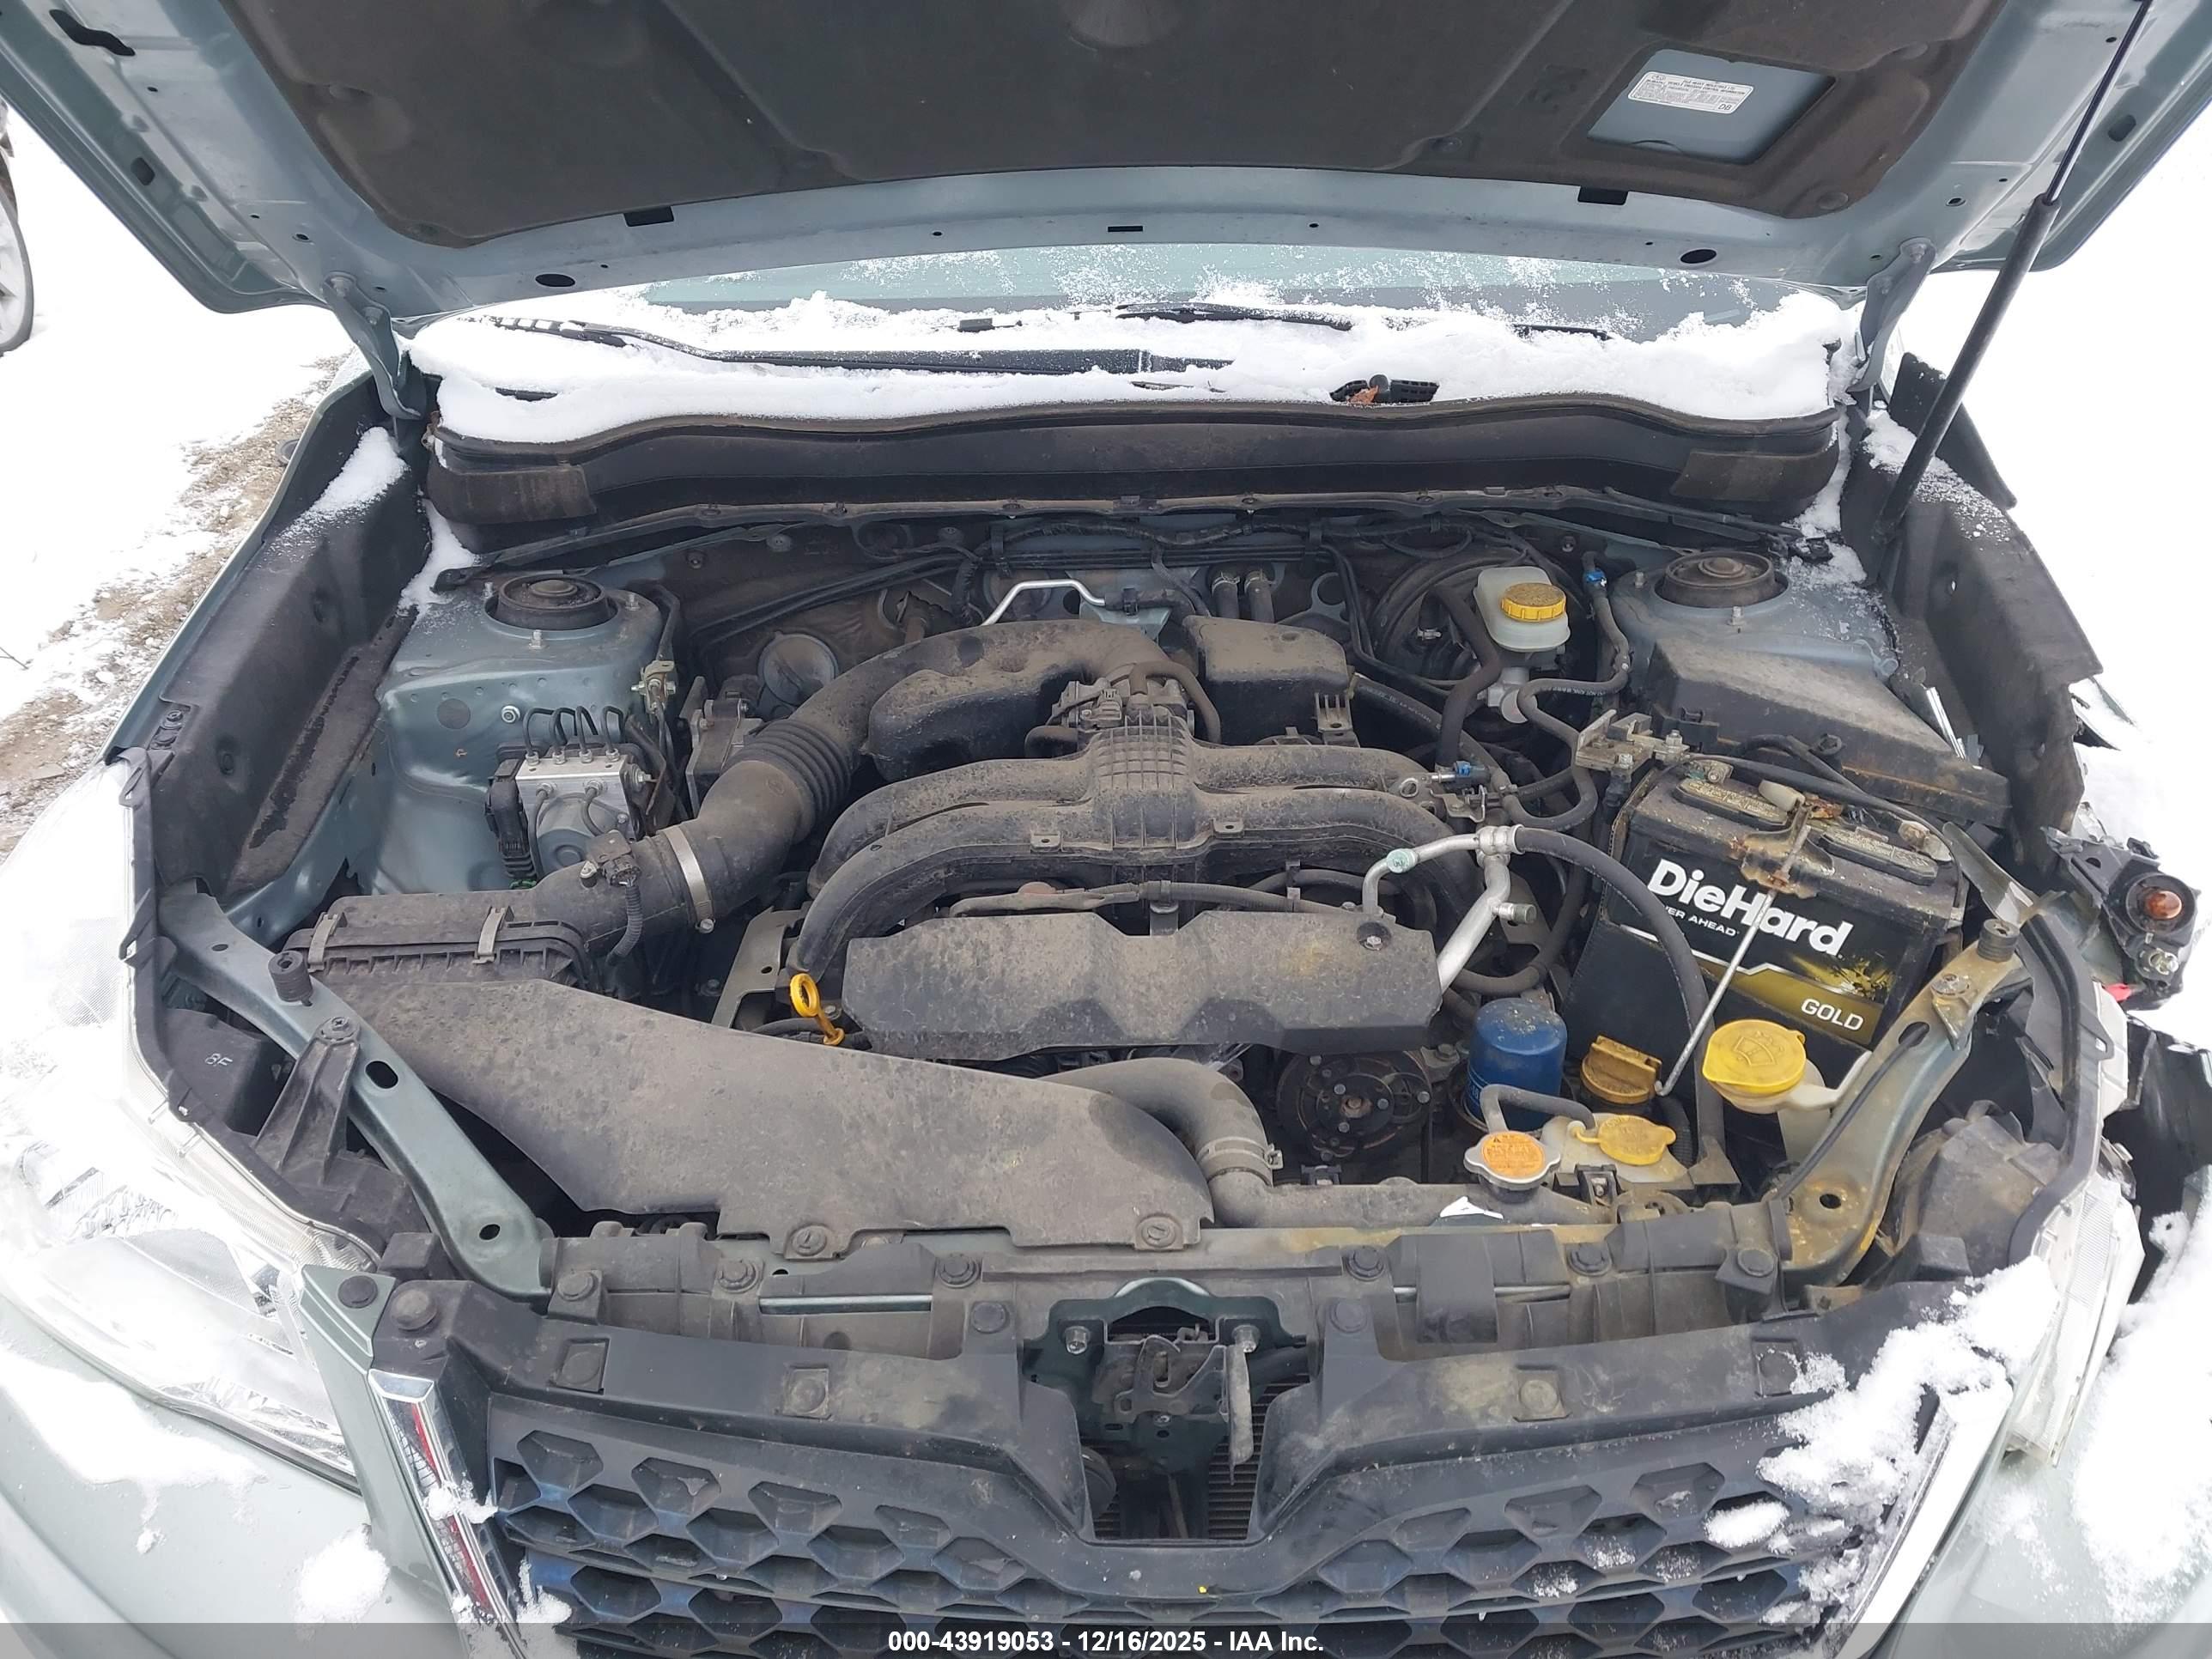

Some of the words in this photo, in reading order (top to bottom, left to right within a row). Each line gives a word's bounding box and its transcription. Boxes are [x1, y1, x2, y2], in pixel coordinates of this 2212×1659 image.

[1647, 859, 1854, 957] DieHard
[1688, 915, 1737, 937] AHEAD
[1801, 997, 1864, 1031] GOLD
